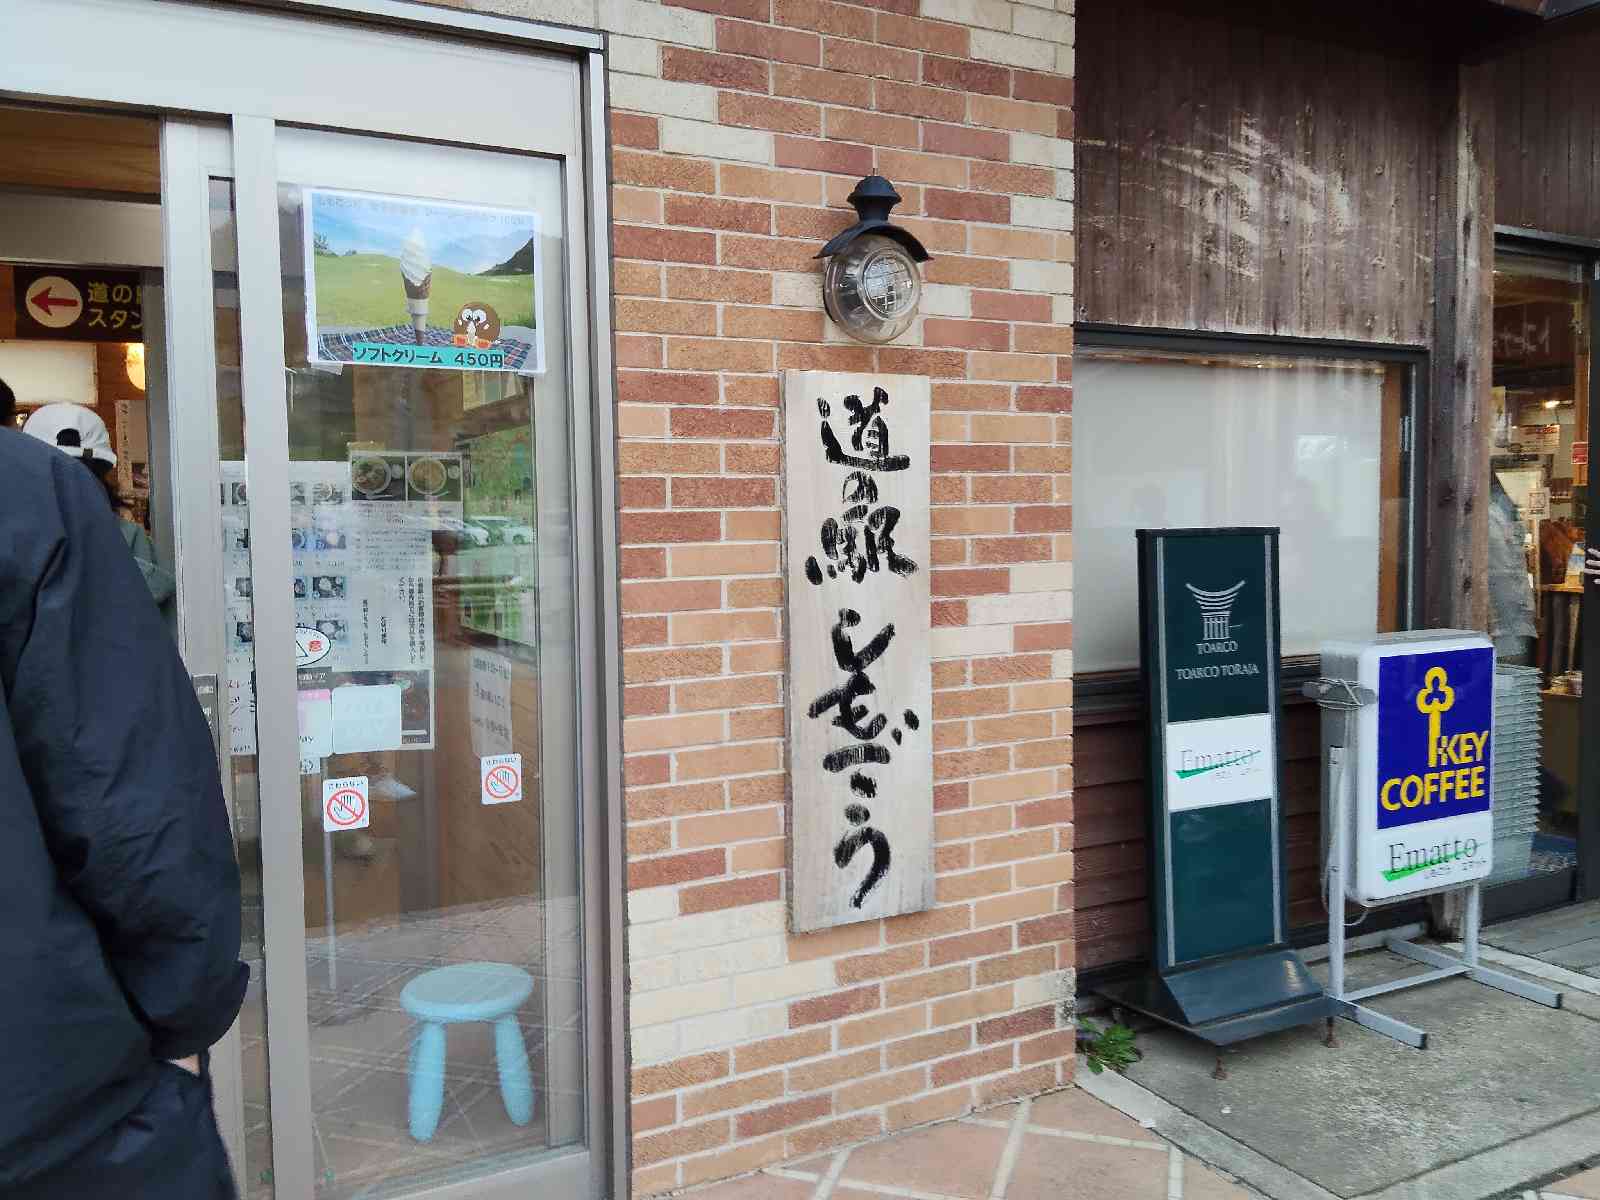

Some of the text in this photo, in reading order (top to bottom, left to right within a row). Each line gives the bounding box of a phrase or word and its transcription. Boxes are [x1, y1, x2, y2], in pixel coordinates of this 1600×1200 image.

[353, 344, 504, 368] ソフトクリーム 450円
[804, 385, 920, 586] 道の駅
[1195, 640, 1239, 655] TOARCO
[1175, 662, 1261, 680] TOARCO TORAJA
[1180, 749, 1255, 772] Ematto
[1439, 730, 1489, 766] KEY
[1380, 765, 1486, 811] COFFEE
[1388, 837, 1478, 873] Ematto
